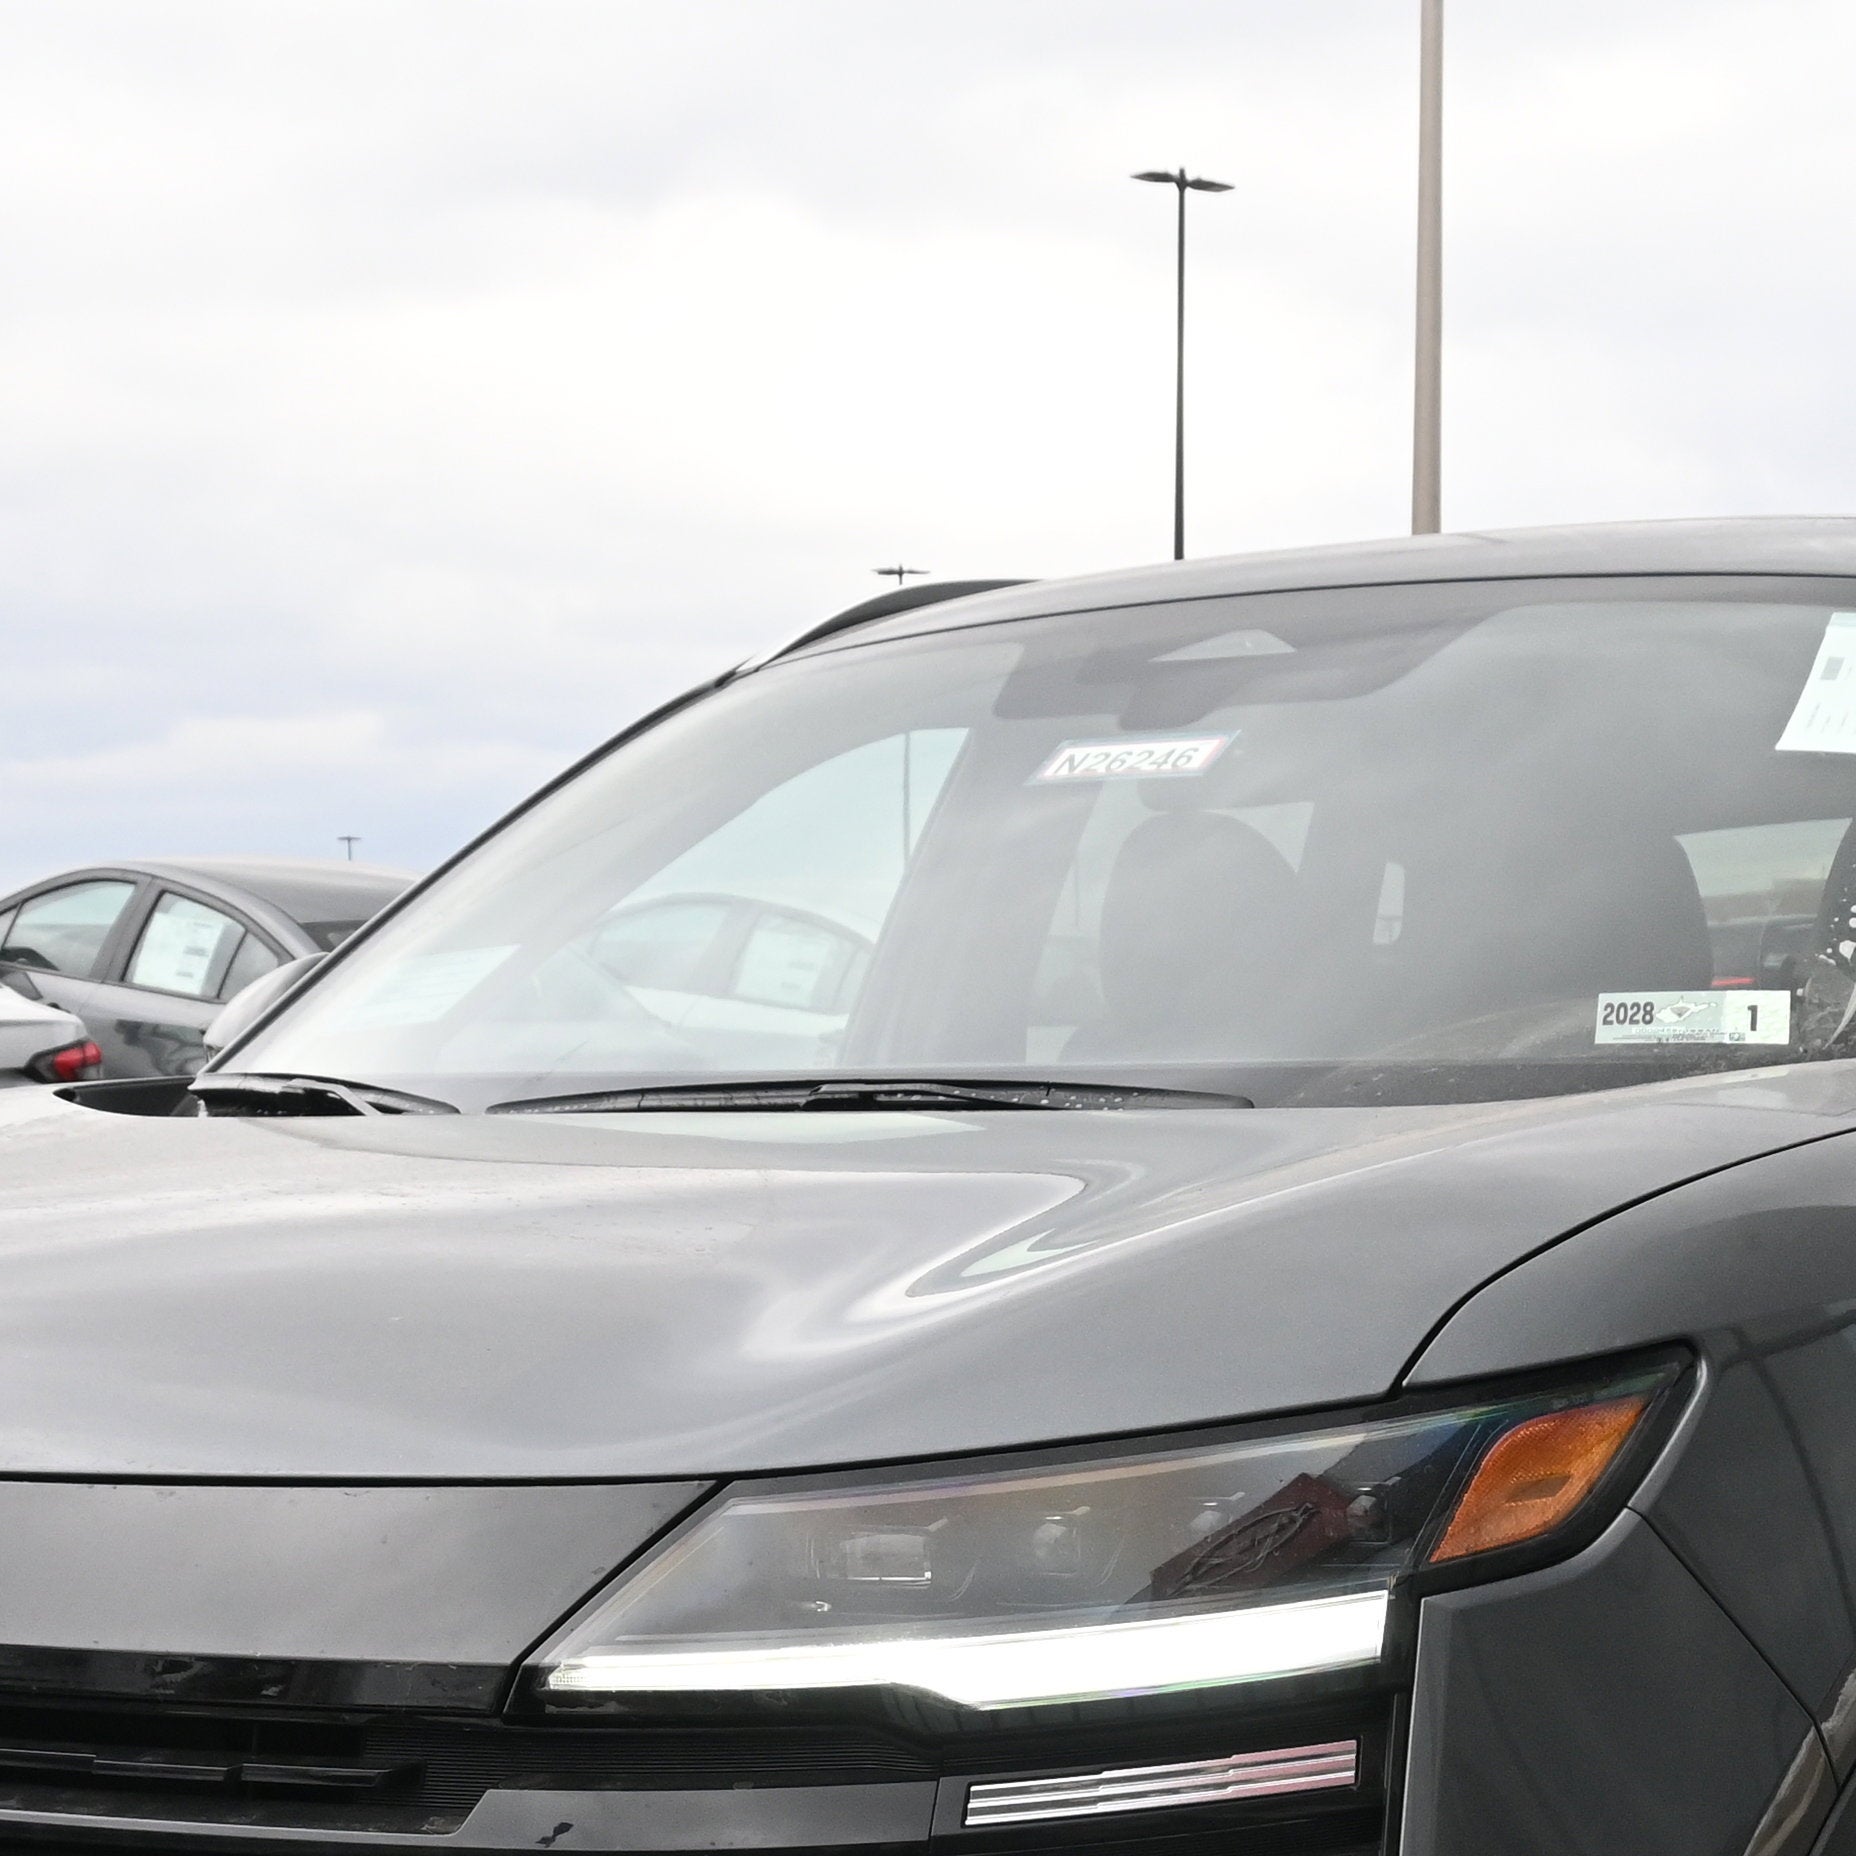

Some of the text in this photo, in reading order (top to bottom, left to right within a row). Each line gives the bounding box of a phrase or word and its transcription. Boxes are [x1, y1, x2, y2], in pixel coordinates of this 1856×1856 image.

[1053, 746, 1200, 775] N26246
[1601, 1001, 1758, 1032] 2028 1
